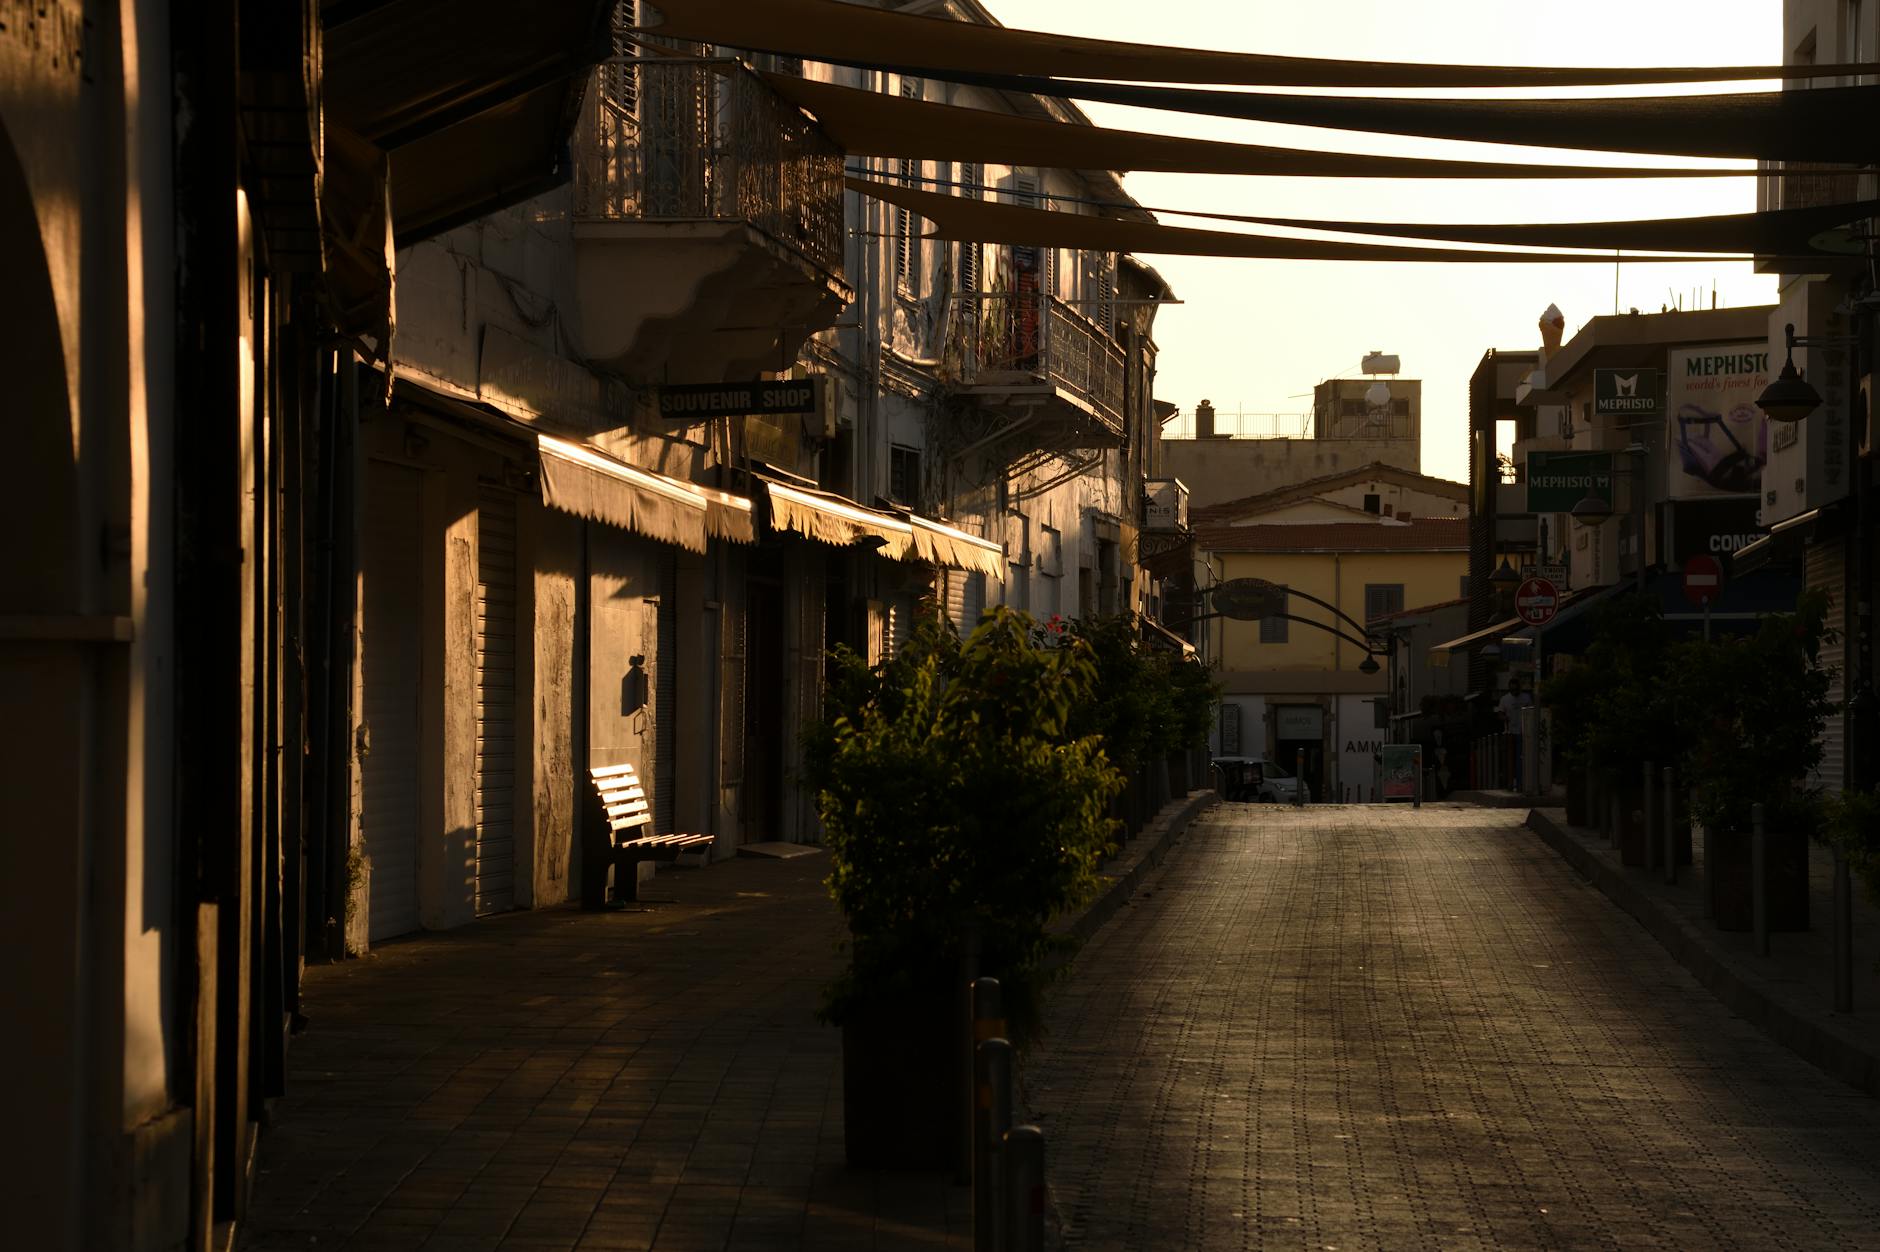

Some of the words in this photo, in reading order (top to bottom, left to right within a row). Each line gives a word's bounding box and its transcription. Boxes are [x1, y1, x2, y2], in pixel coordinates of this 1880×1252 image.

[661, 391, 752, 412] SOUVENIR
[763, 388, 811, 408] SHOP
[1599, 398, 1654, 410] MEPHISTO
[1531, 475, 1592, 488] MEPHISTO
